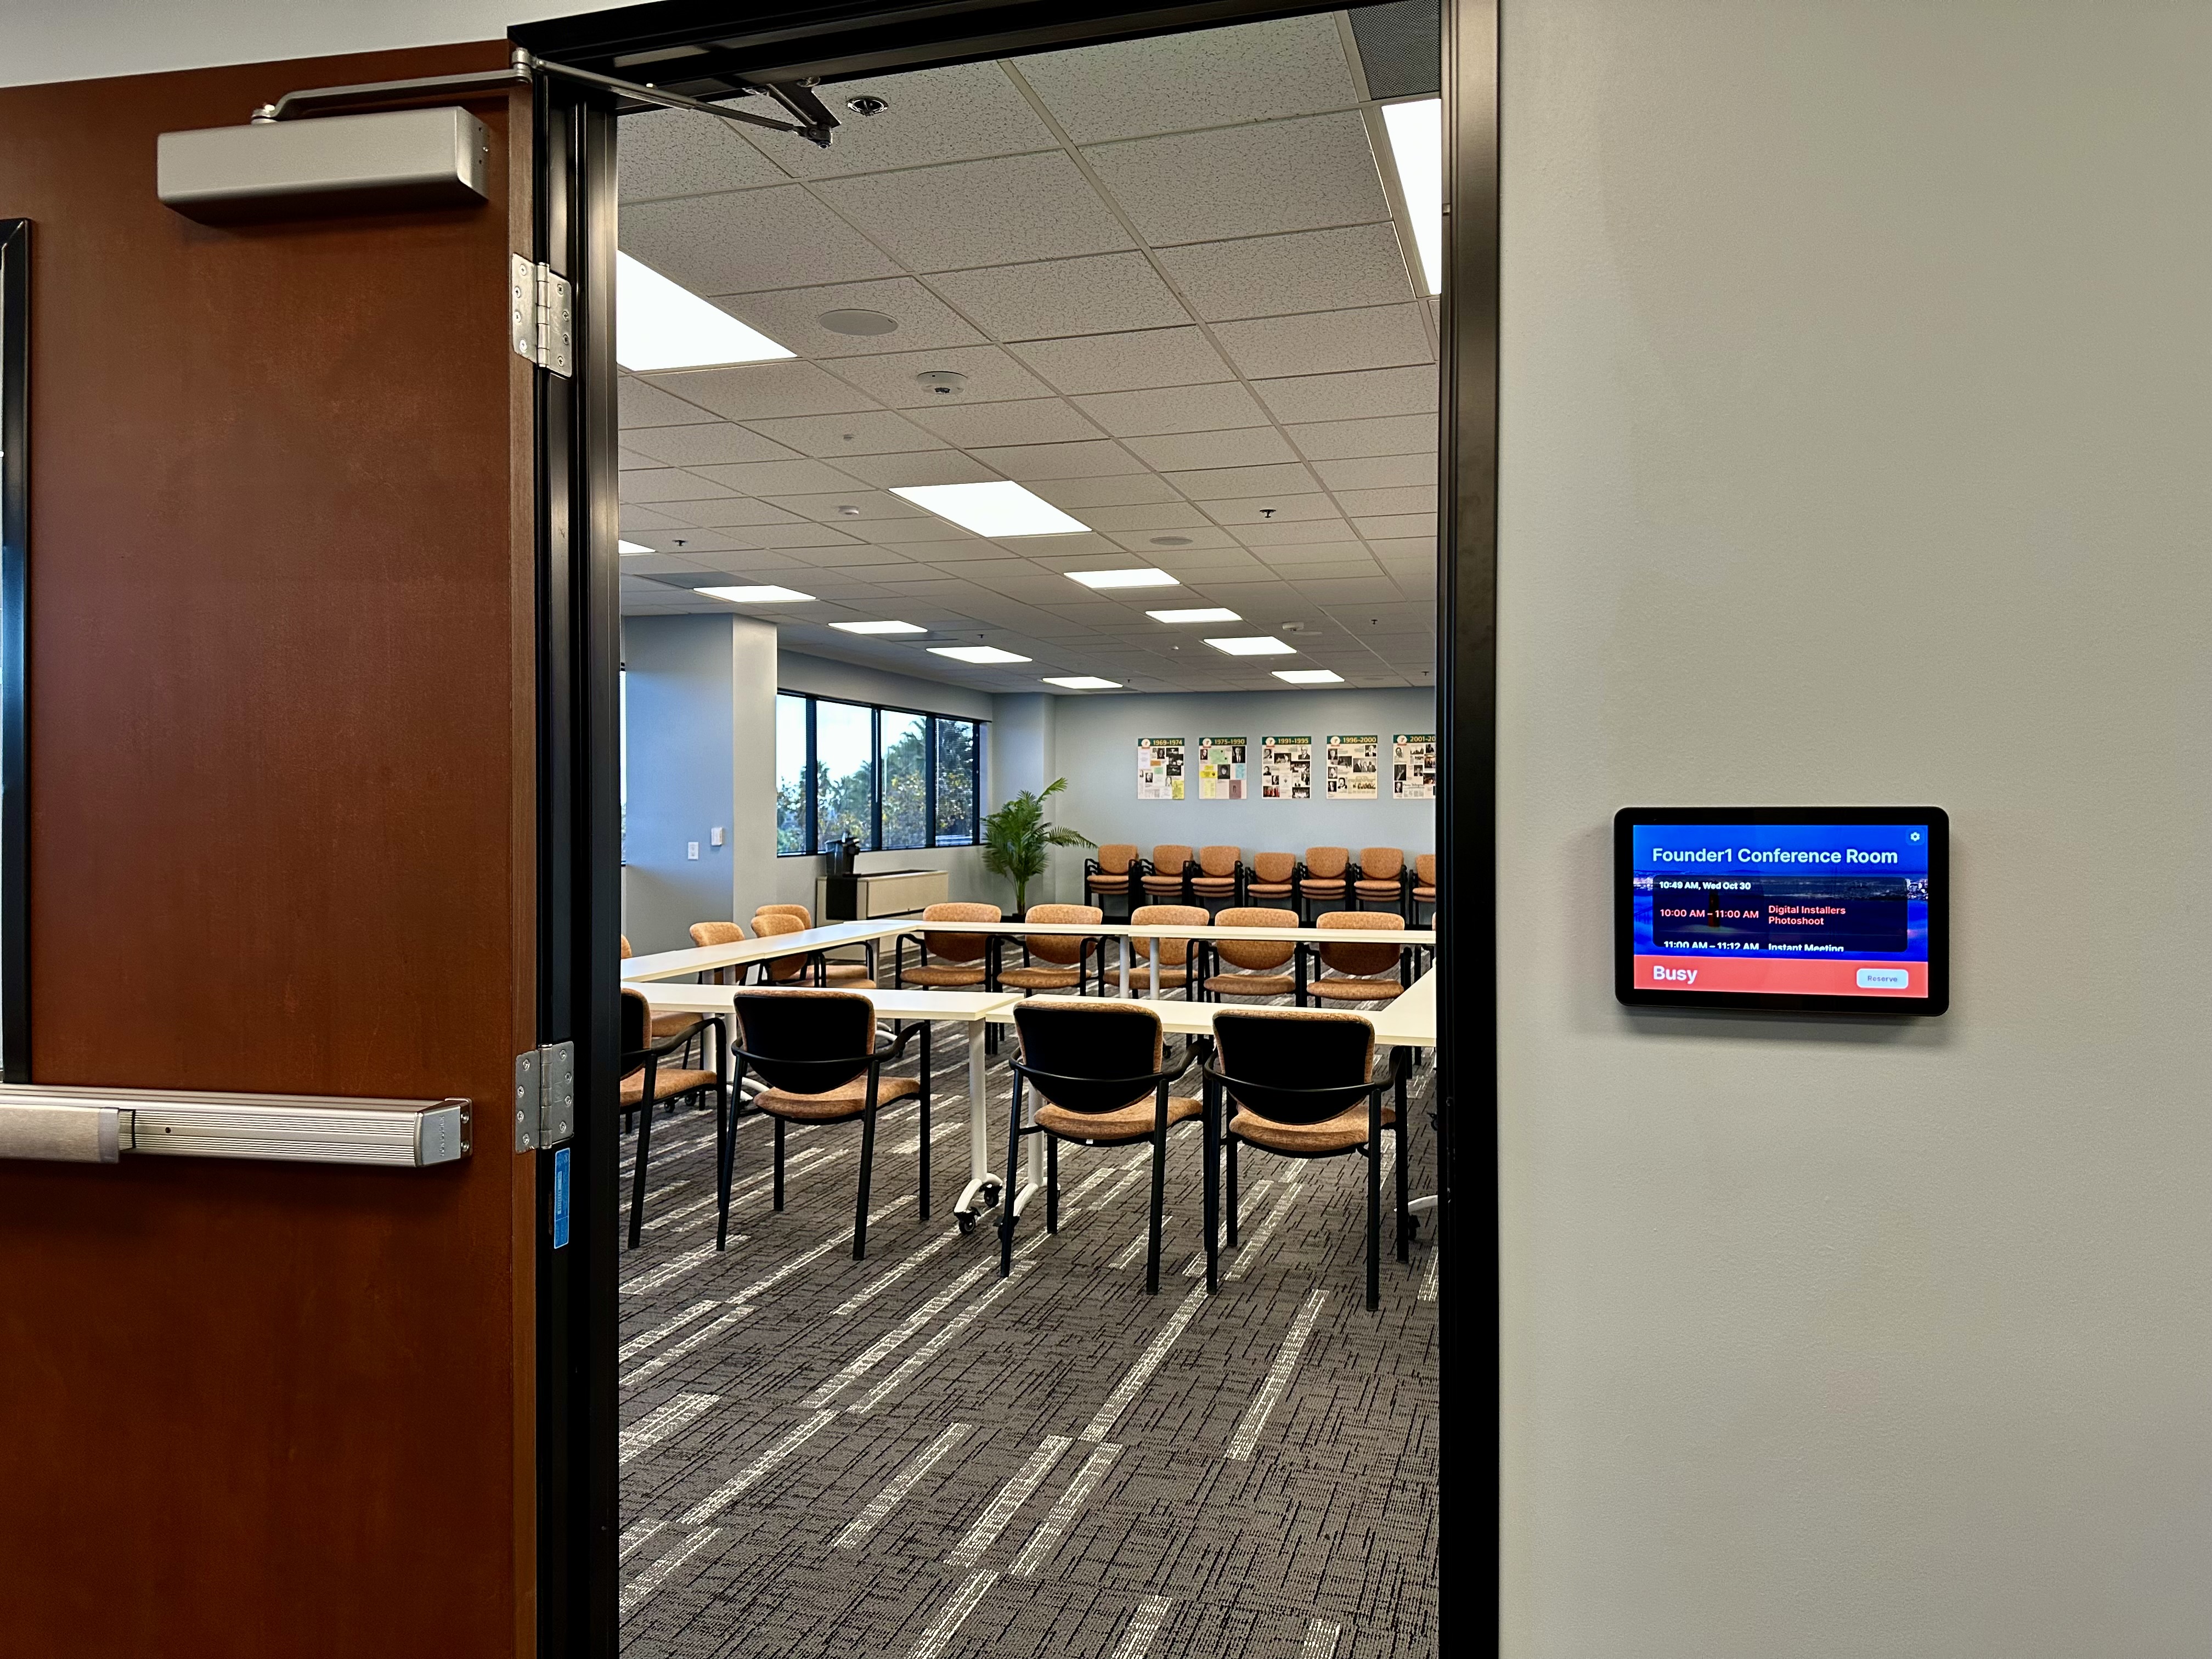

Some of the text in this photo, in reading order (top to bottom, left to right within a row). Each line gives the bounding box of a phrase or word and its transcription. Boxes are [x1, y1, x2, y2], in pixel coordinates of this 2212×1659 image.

[1653, 848, 1898, 864] Founder1 Conference Room
[1684, 882, 1701, 890] AM,
[1769, 905, 1846, 915] Digital Installers
[1769, 916, 1824, 925] Photoshoot
[1654, 966, 1698, 984] Busy
